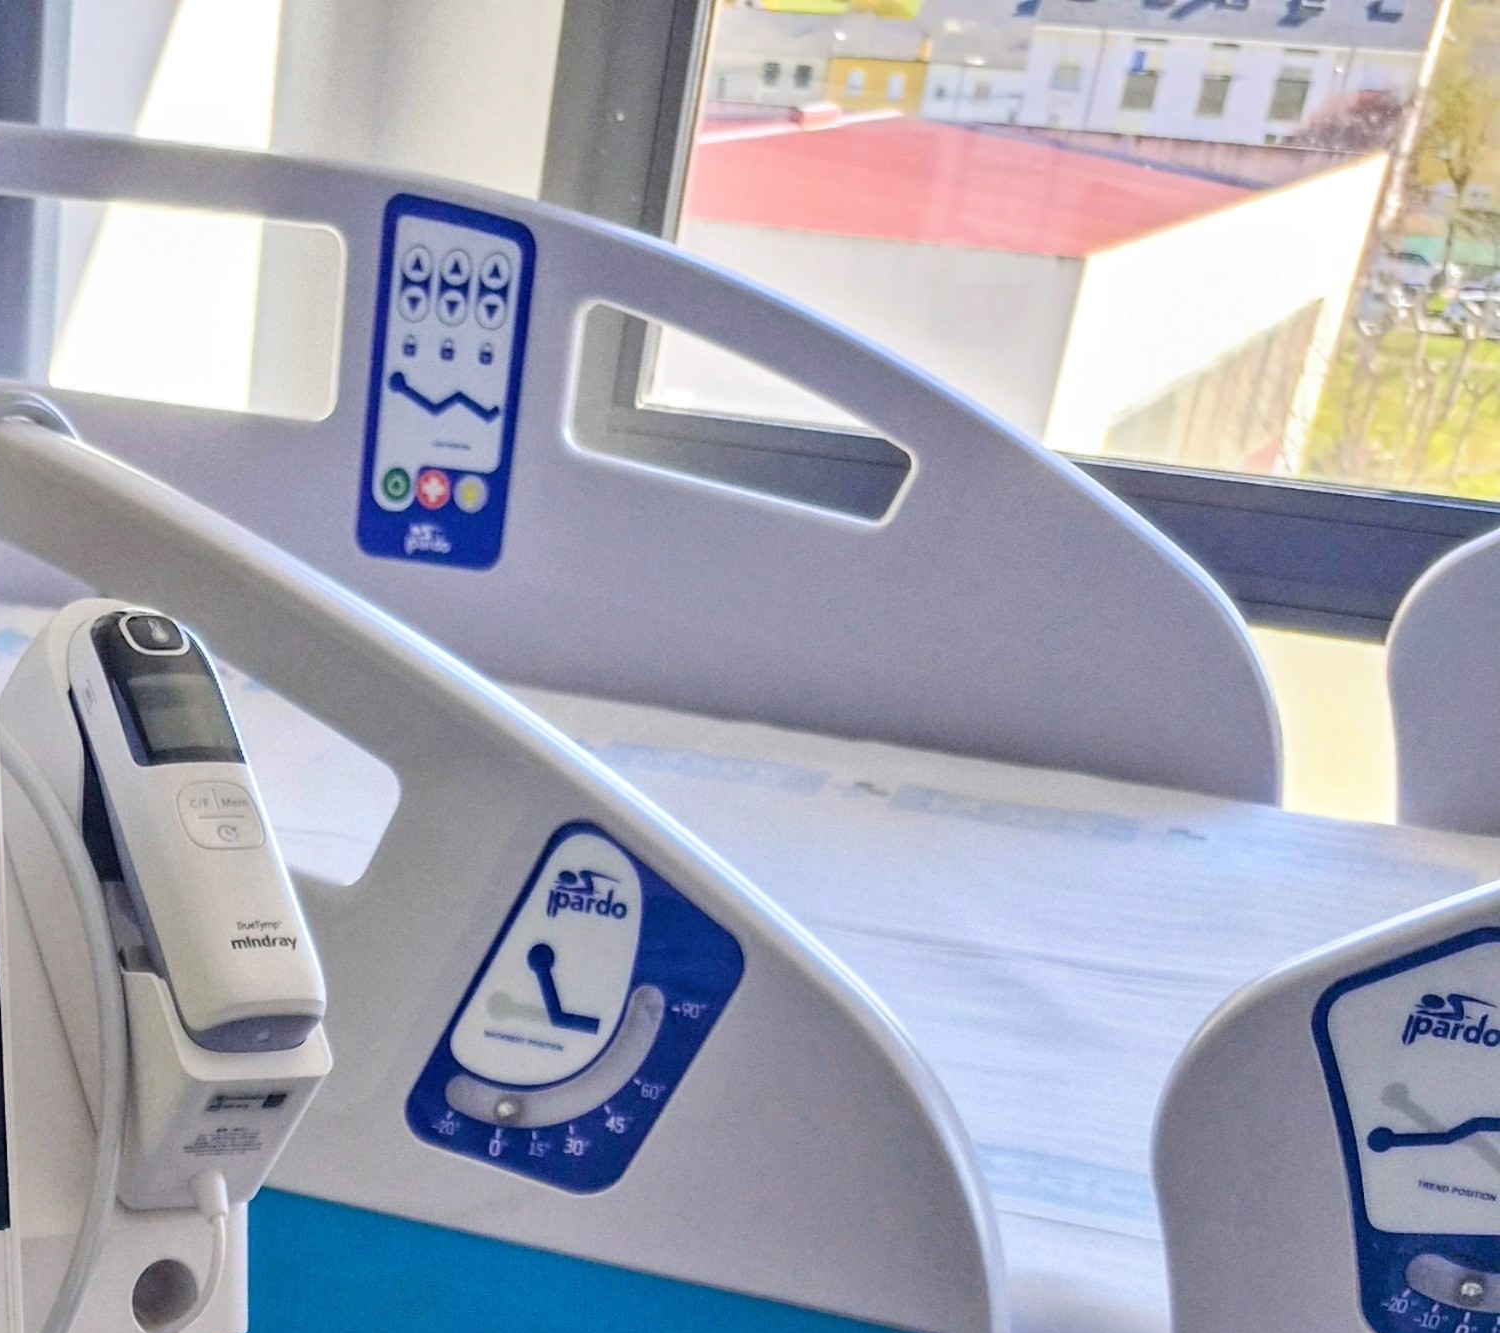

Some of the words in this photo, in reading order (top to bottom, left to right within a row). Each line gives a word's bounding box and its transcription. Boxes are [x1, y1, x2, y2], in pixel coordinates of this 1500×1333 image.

[231, 934, 298, 951] mindray
[1418, 1179, 1450, 1193] TREND
[1451, 1187, 1497, 1201] POSITION
